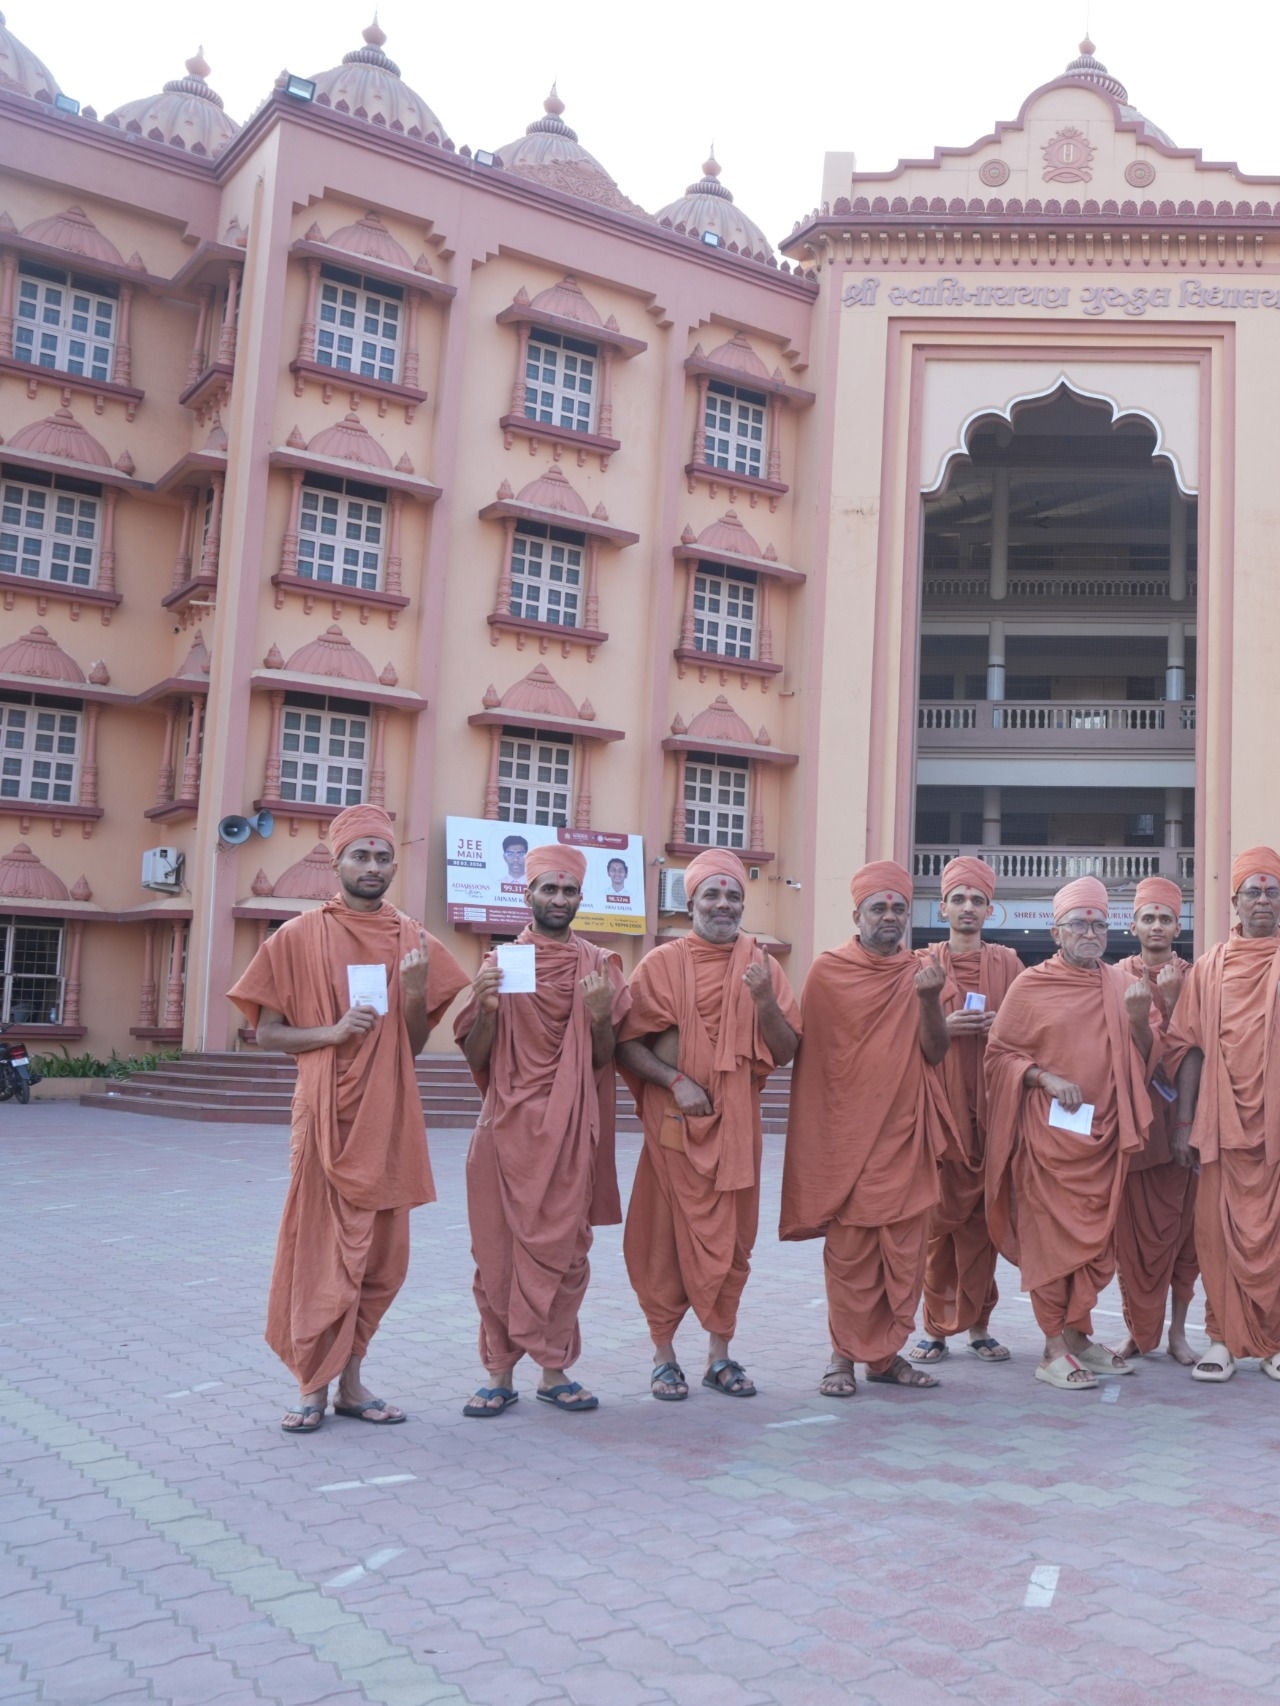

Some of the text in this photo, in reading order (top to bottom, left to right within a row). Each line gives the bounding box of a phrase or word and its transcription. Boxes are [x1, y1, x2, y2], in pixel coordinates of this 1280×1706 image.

[841, 277, 881, 308] શ્રી
[888, 277, 1071, 309] સ્વામિનારાયણ
[457, 838, 483, 851] JEE
[457, 850, 483, 860] MAIN
[1013, 911, 1036, 919] SHREE
